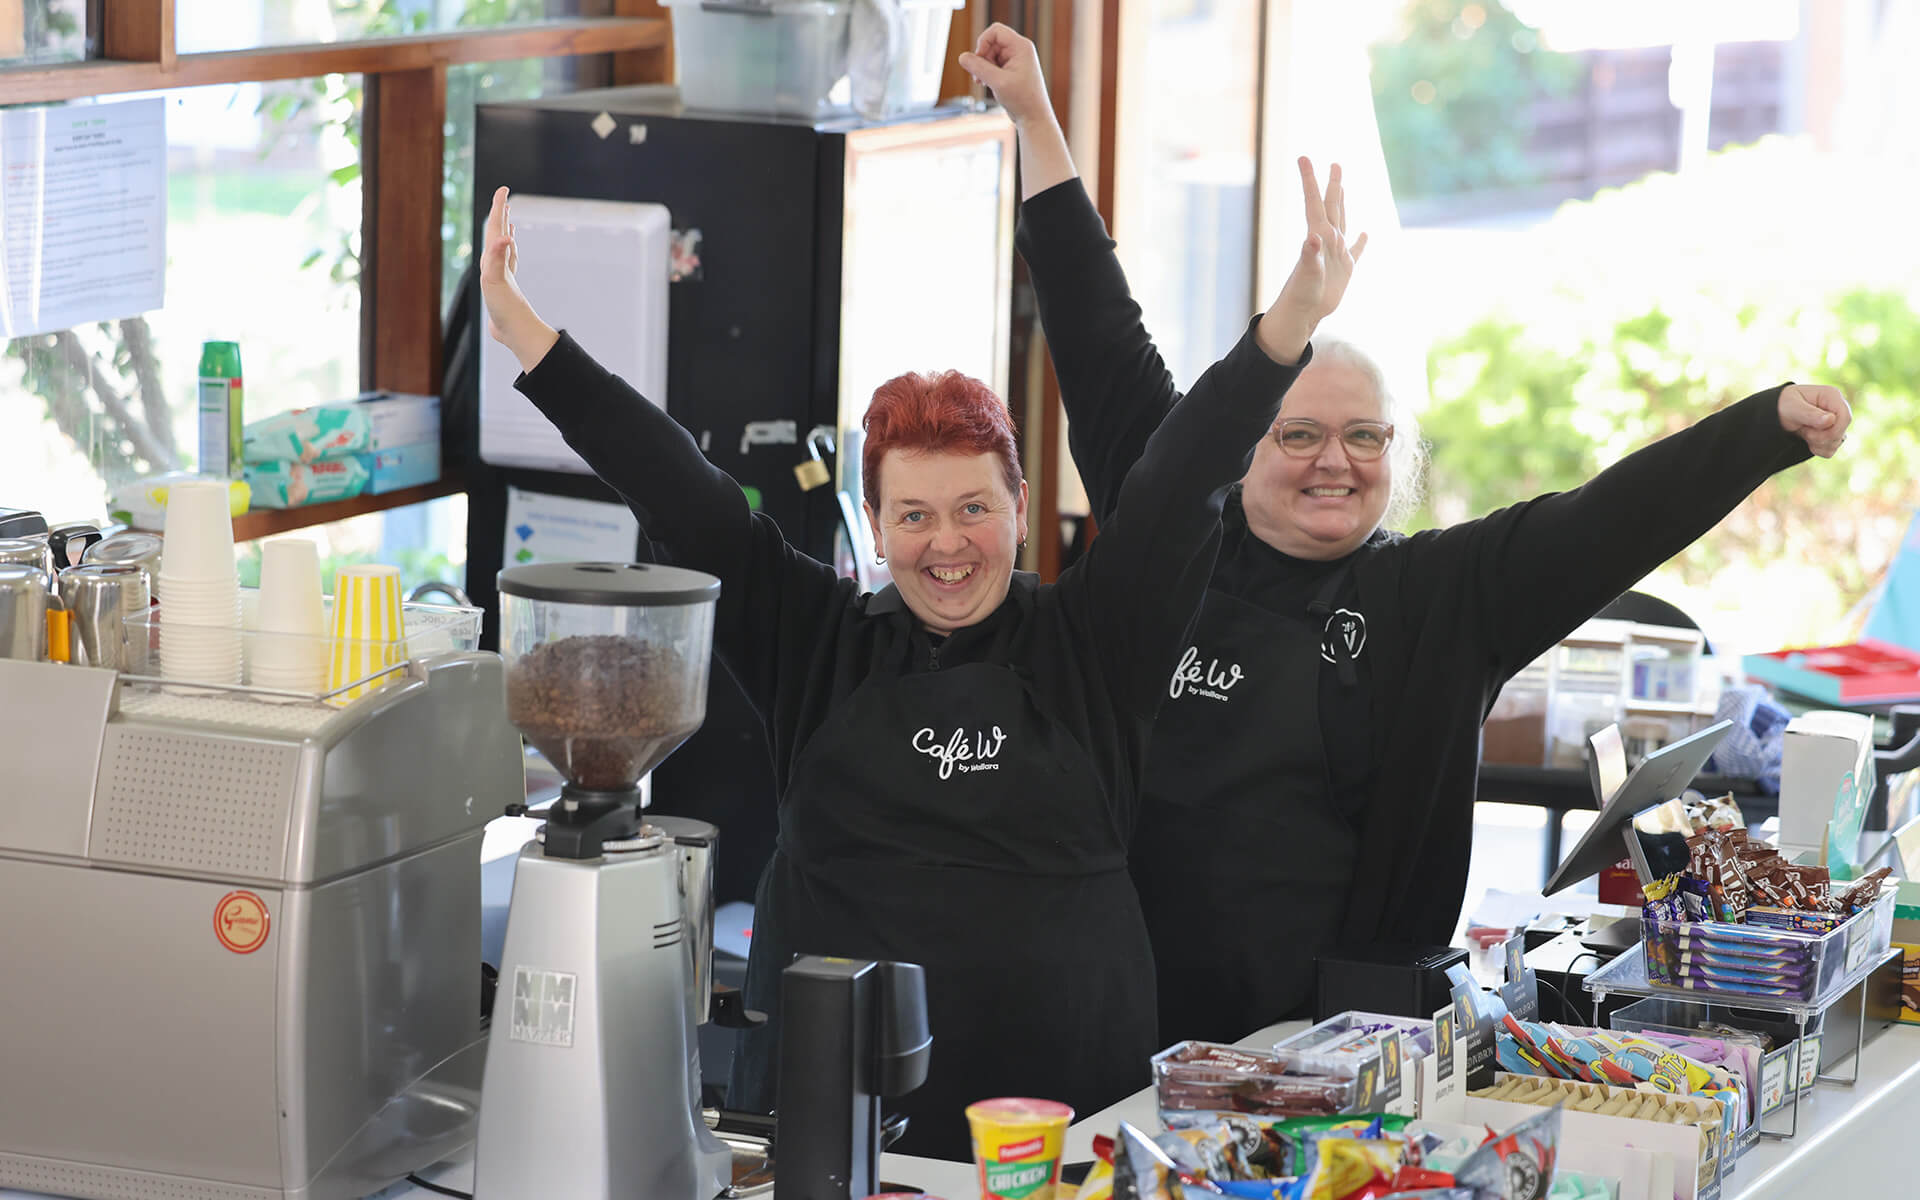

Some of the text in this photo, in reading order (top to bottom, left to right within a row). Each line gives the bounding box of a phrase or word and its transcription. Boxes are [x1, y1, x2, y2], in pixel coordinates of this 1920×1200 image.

[1168, 645, 1244, 699] fé W
[1187, 684, 1229, 702] by Wallara
[911, 725, 1007, 780] Café W
[958, 762, 999, 773] by Wallara
[989, 1165, 1048, 1191] CHICKEN
